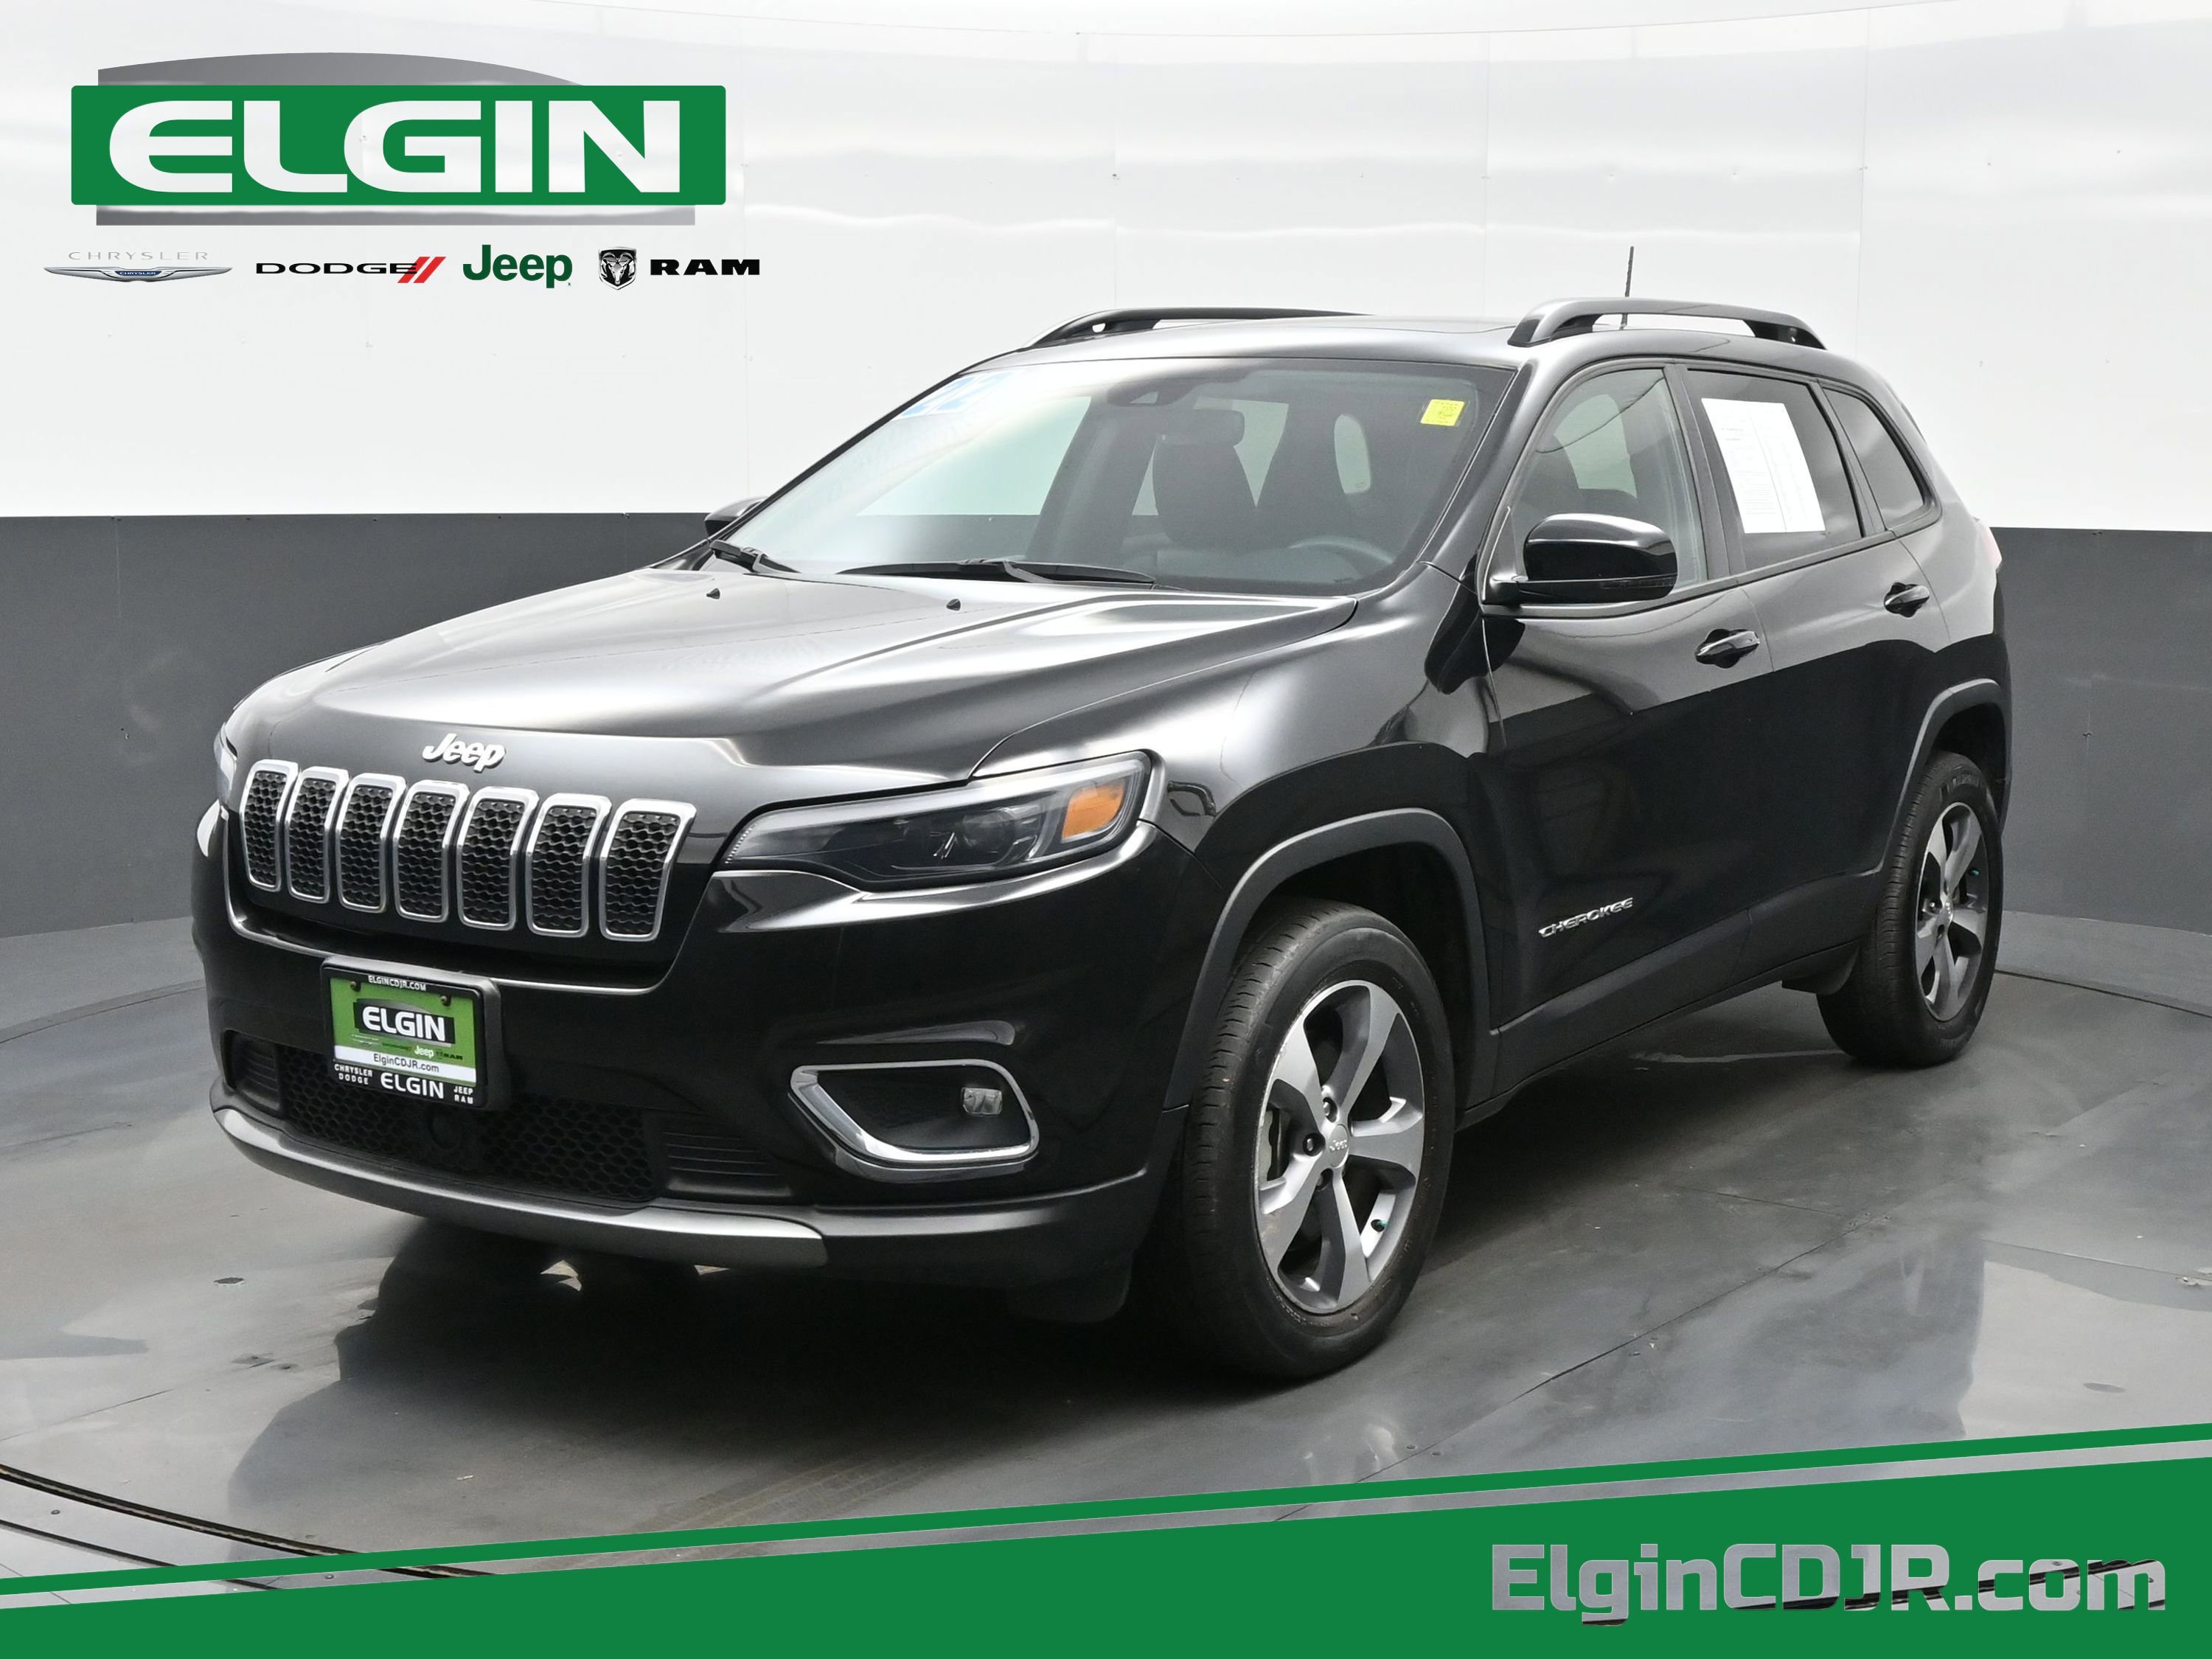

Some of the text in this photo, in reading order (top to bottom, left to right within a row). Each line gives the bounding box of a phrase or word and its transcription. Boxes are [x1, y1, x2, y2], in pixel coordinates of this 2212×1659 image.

[422, 733, 507, 773] Jeep
[1538, 897, 1634, 938] CHEROKEE
[368, 975, 427, 992] ELGINCDJR.COM
[362, 1006, 445, 1042] ELGIN
[414, 1045, 434, 1059] Jeep
[334, 1063, 373, 1077] CHRYSLER
[373, 1053, 440, 1074] ElginCDJR.com
[338, 1073, 369, 1085] DODGE
[380, 1072, 445, 1099] ELGIN
[453, 1085, 474, 1096] JEEP
[454, 1093, 474, 1105] RAM
